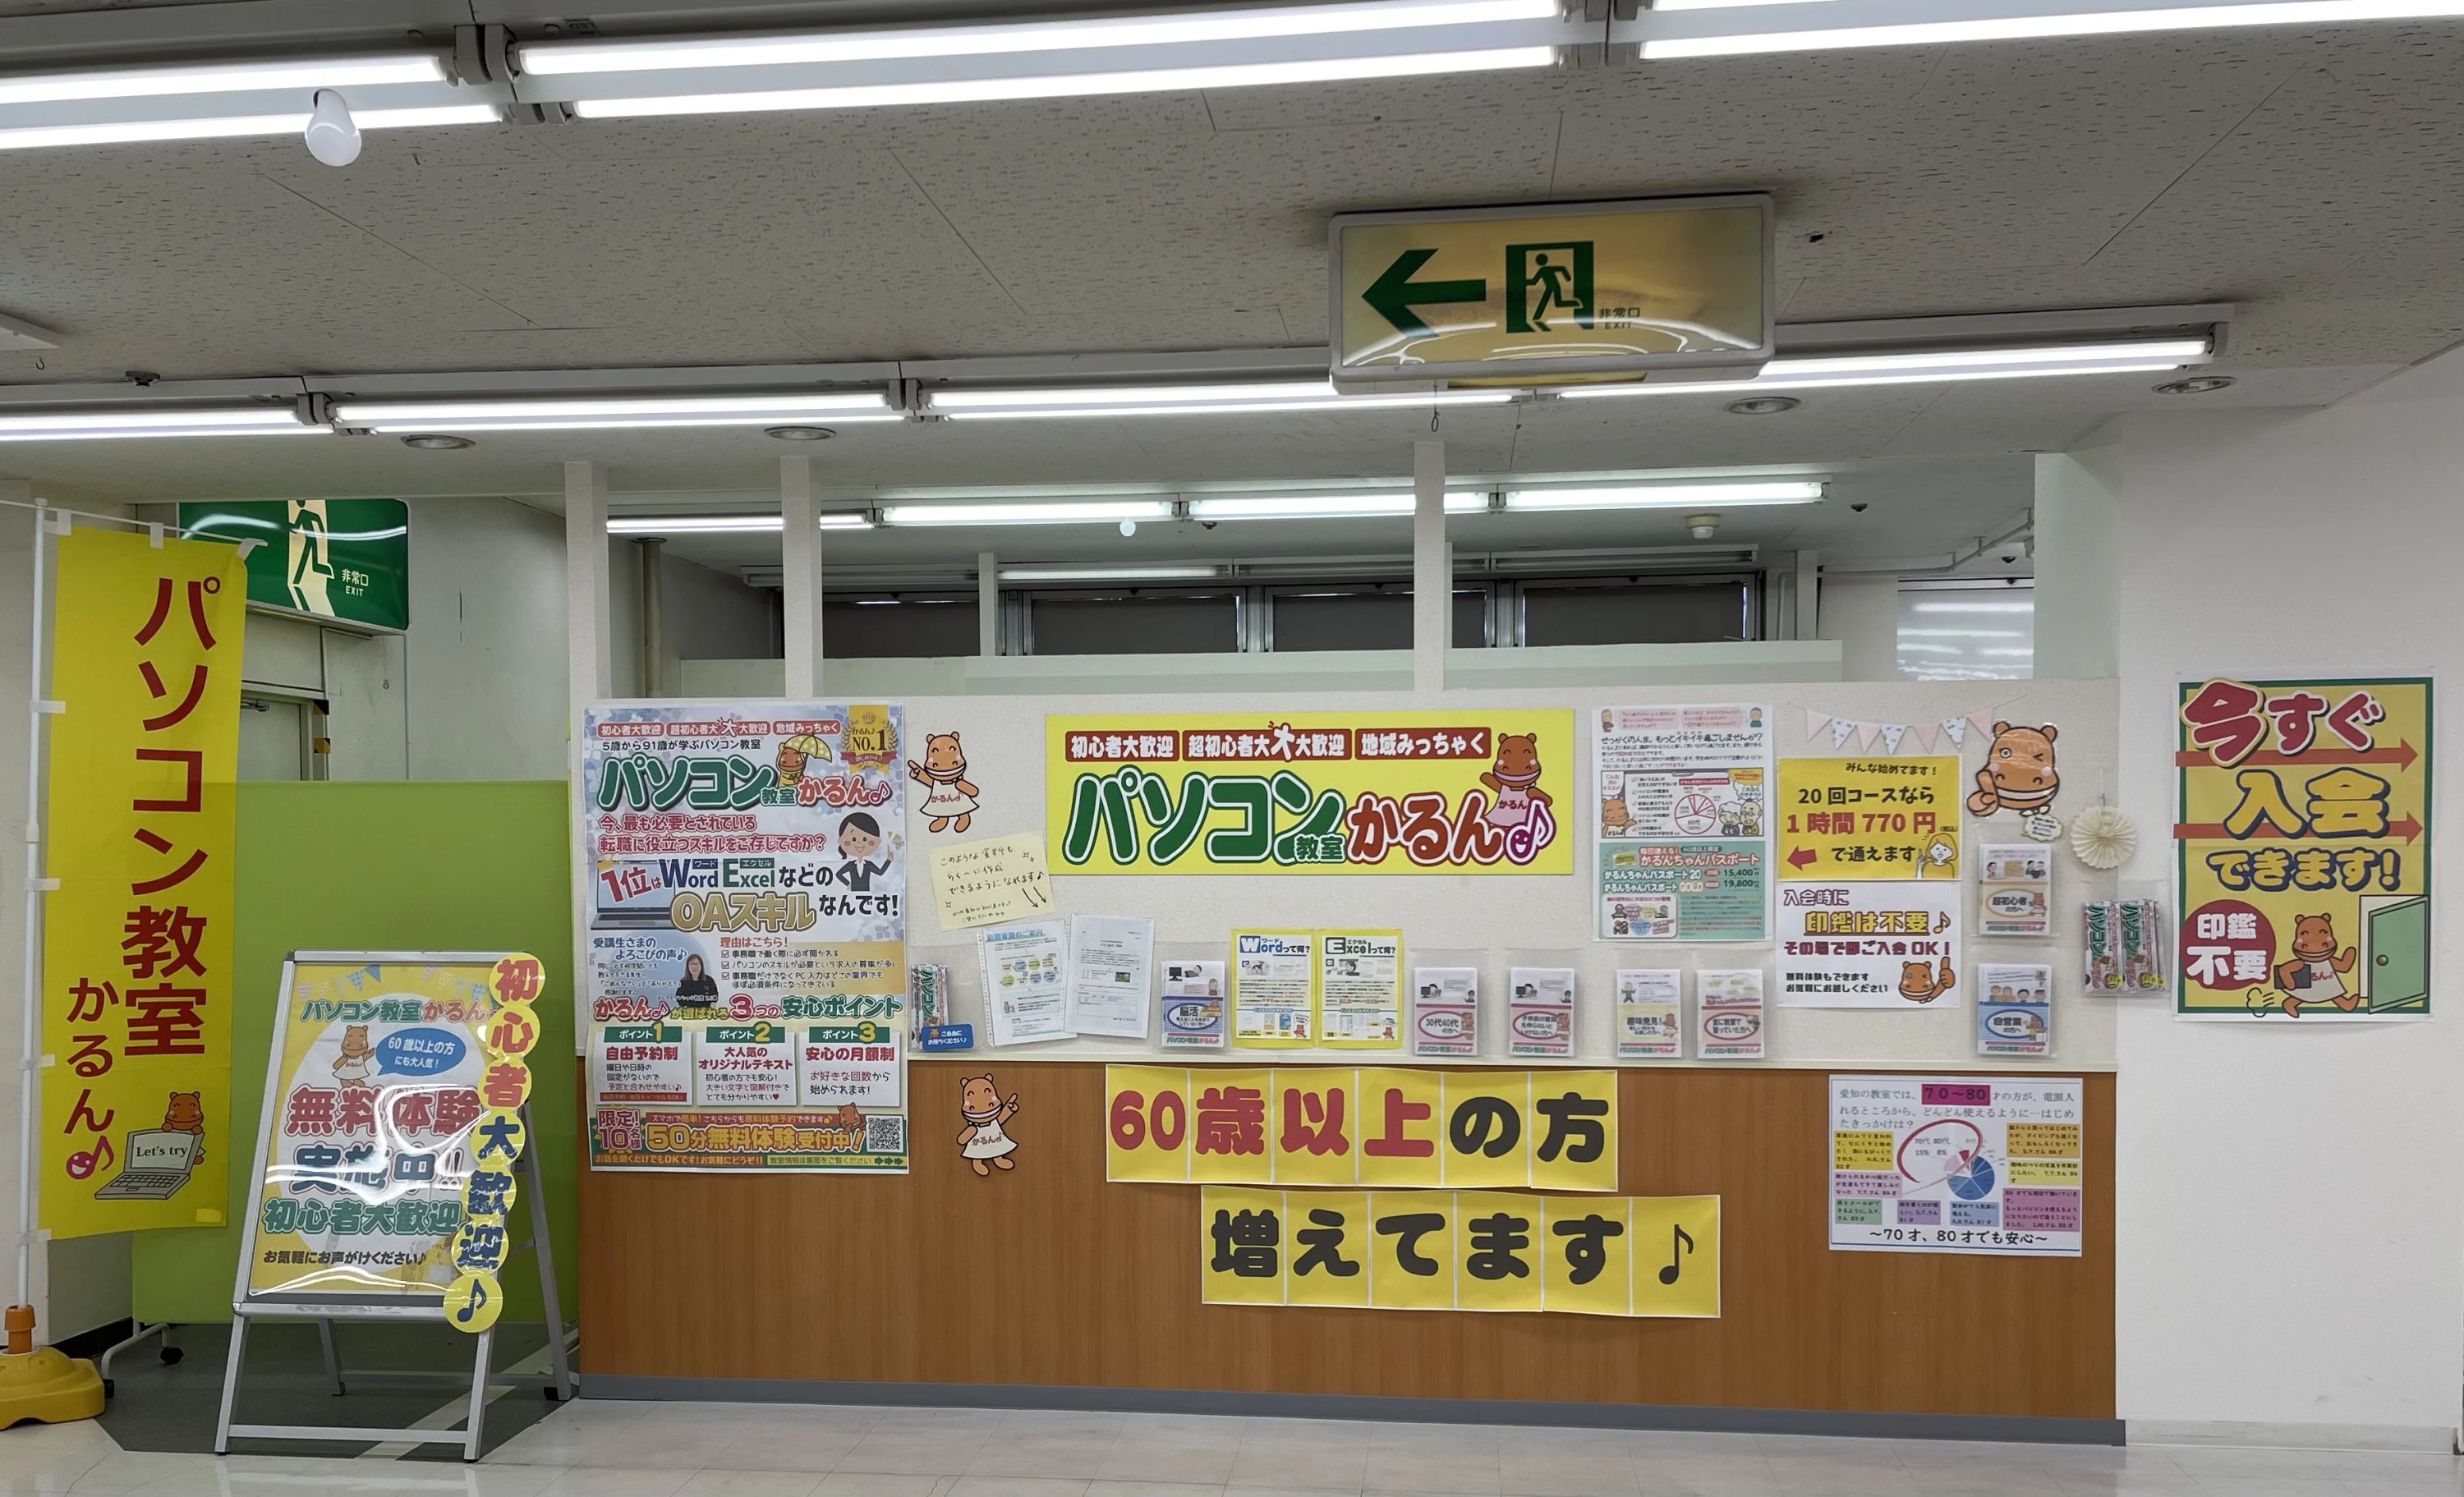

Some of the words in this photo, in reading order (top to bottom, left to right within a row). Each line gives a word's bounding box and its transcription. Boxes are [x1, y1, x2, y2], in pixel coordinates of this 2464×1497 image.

[1599, 307, 1640, 319] 非常口
[342, 569, 369, 587] 非常口
[346, 585, 364, 597] EXIT
[601, 723, 662, 736] 初心者大歓迎
[2181, 677, 2385, 769] 今すぐ
[602, 738, 761, 751] 5歳から91歳が学ぶパソコン教室
[852, 728, 888, 751] NO.1
[1071, 735, 1175, 758] 初心者大歓迎
[1361, 730, 1486, 756] 地域みっちゃく
[1845, 761, 1938, 777] みんな始めてます!
[2223, 766, 2392, 840] 入会
[122, 576, 221, 1057] パソコン教室
[599, 814, 757, 833] 今、最も必要とされている
[1832, 845, 1916, 863] で通えます
[2205, 847, 2401, 892] できます!
[1783, 889, 1850, 907] 入会時に
[2196, 912, 2257, 940] 印鑑
[593, 937, 656, 949] 受講生さまの
[719, 937, 788, 948] 理由はこちら!
[2186, 945, 2268, 985] 不要
[1786, 972, 1870, 982] 無料体験もできます
[606, 1045, 678, 1062] 自由予約制
[724, 1046, 768, 1058] 大人気の
[805, 1046, 895, 1062] 安心の月額制
[698, 1059, 793, 1071] オリジナルテキスト
[810, 1070, 890, 1082] お好きな回数から
[285, 1086, 482, 1137] 無料体験
[1109, 1086, 1610, 1164] 60歳以上の方
[136, 1146, 165, 1157] Let's
[169, 1146, 187, 1158] try
